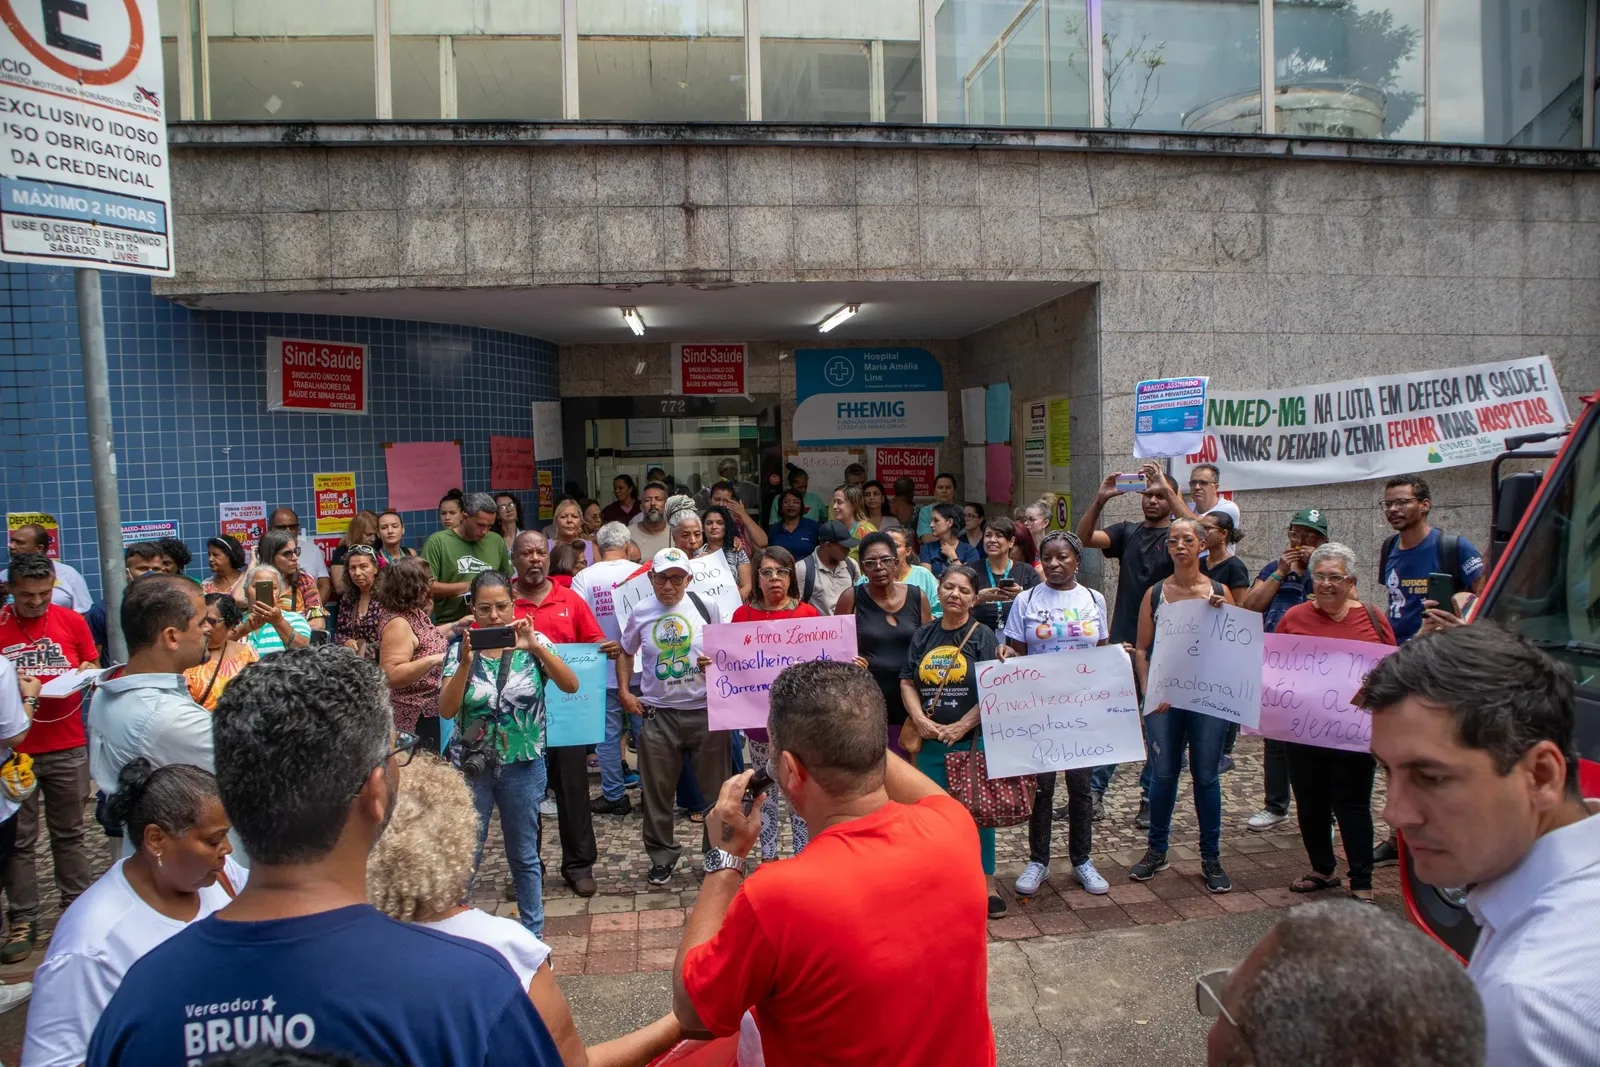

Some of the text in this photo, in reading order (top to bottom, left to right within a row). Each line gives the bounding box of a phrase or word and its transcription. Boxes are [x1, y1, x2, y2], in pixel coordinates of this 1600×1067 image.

[0, 57, 31, 76] CIO
[109, 121, 158, 145] IDOSO
[45, 131, 162, 167] OBRIGATÓRIO
[11, 149, 154, 188] DA CREDENCIAL
[12, 188, 157, 225] MÁXIMO 2 HORAS
[11, 219, 36, 231] USE
[40, 223, 50, 232] O
[113, 252, 139, 262] LIVRE
[285, 345, 361, 370] Sind-Saúde
[683, 348, 742, 364] Sind-Saúde
[864, 352, 899, 361] Hospital
[864, 362, 918, 371] Maria Amélia
[292, 371, 321, 380] SINDICATO
[340, 374, 352, 382] DOS
[864, 373, 883, 382] Lins
[293, 381, 342, 391] TRABALHADORES
[1142, 380, 1198, 393] ABAIXO-ASSINADO
[288, 389, 356, 401] SAÚDE DE MINAS GERAIS
[1140, 393, 1159, 401] CONTRA
[1165, 388, 1201, 398] PRIVATIZAÇÃO
[1207, 396, 1306, 427] NMED-MG
[1314, 393, 1333, 424] NA
[1337, 387, 1375, 421] LUTA
[1379, 384, 1404, 416] EM
[1407, 377, 1463, 412] DEFESA
[1465, 373, 1490, 403] DA
[1489, 364, 1549, 398] SAÚDE!
[661, 400, 685, 412] 772
[837, 401, 905, 418] FHEMIG
[1220, 434, 1272, 462] VAMOS
[1277, 431, 1328, 461] DEIXAR
[1331, 429, 1341, 457] O
[1344, 424, 1386, 456] ZEMA
[1387, 416, 1441, 449] FECHAR
[1436, 409, 1479, 440] MAIS
[1474, 397, 1554, 433] HOSPITAIS
[1438, 438, 1473, 452] SINMED
[877, 451, 934, 467] Sind-Saúde
[319, 492, 338, 500] SAÚDE
[320, 508, 354, 516] MERCADORIA
[9, 516, 57, 525] DEPUTADOS
[226, 522, 247, 530] SAÚDE
[1462, 557, 1482, 572] BRUNO
[600, 597, 613, 605] SAÚ
[1211, 612, 1252, 645] Não
[1187, 639, 1200, 656] é
[979, 663, 1096, 689] Contra a
[979, 686, 1134, 716] Privatização dos
[1261, 677, 1303, 709] stá
[989, 714, 1089, 743] Hospitais
[185, 998, 258, 1018] Vereador
[184, 1013, 316, 1057] BRUNO
